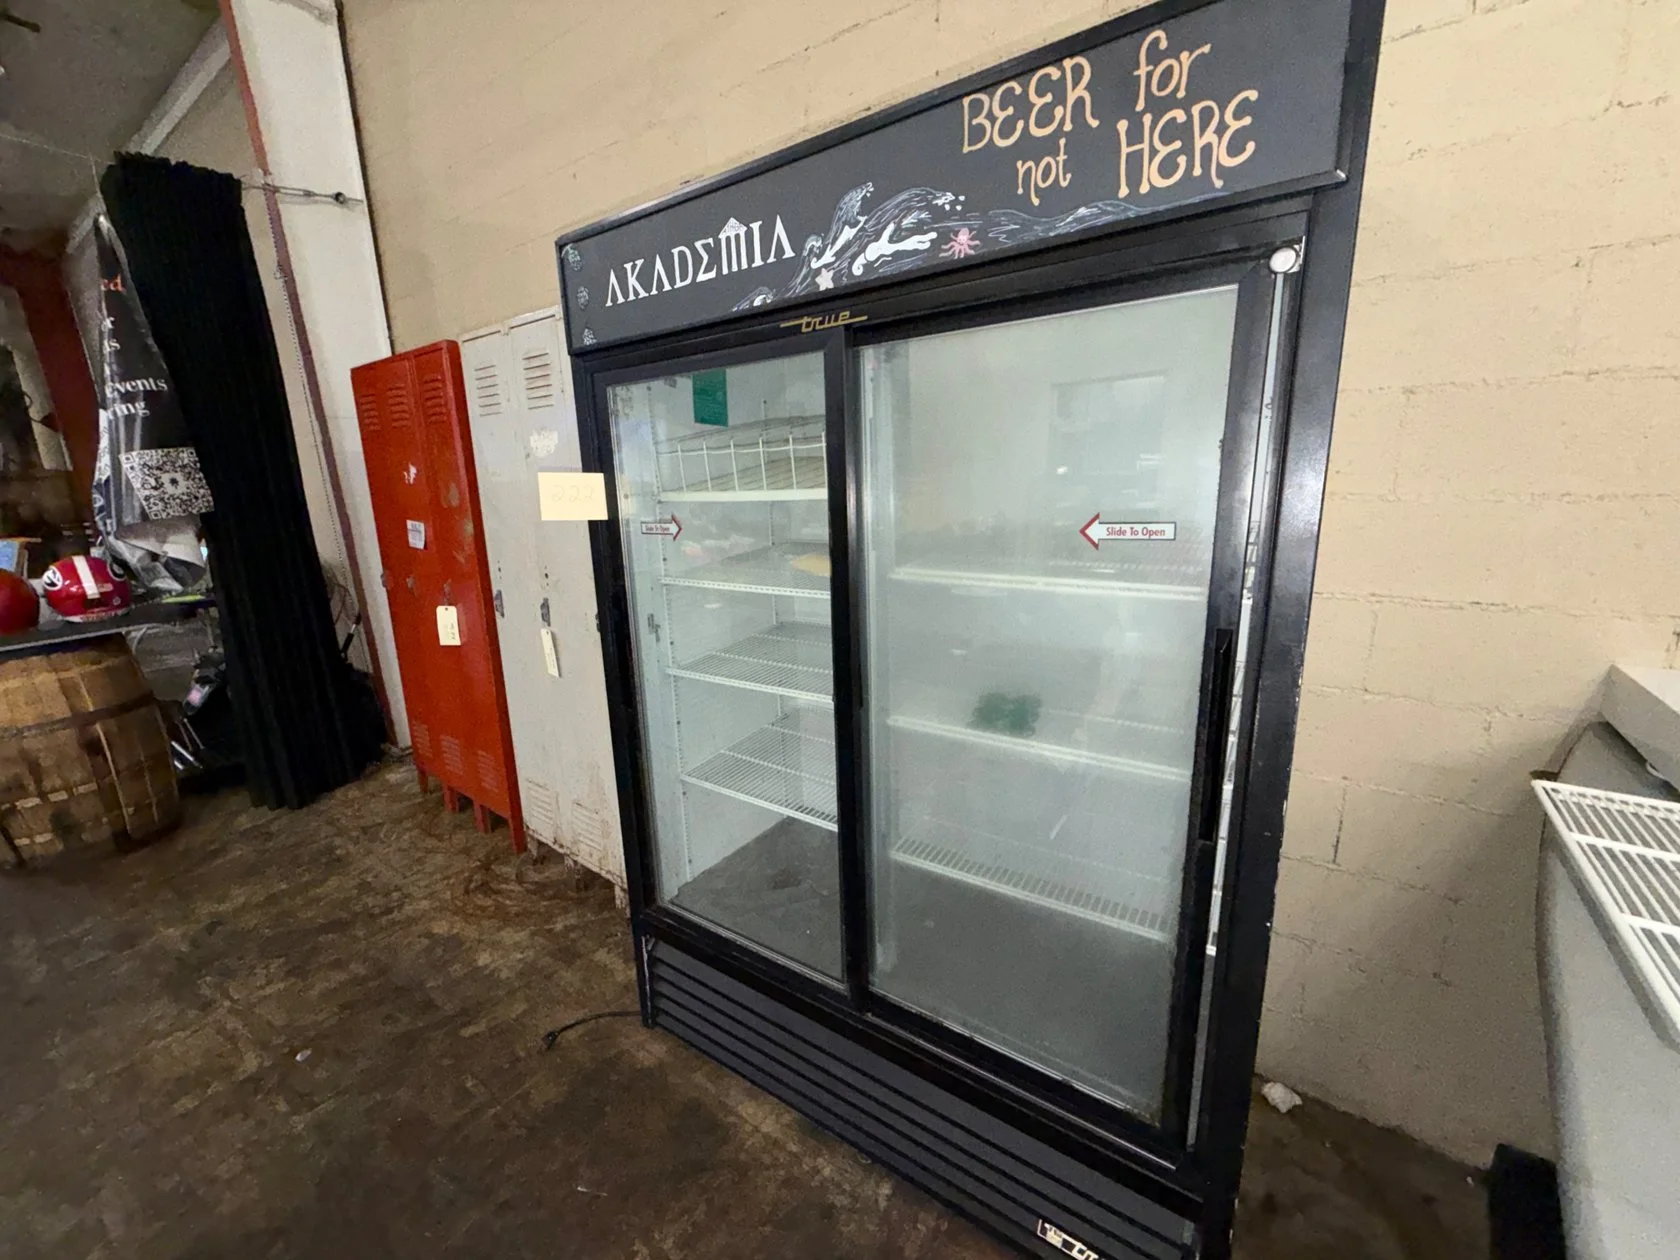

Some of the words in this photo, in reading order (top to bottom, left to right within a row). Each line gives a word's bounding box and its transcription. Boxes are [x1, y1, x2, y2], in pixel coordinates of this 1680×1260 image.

[963, 56, 1099, 153] BEER
[1133, 29, 1211, 112] for
[1016, 138, 1071, 206] not
[1117, 89, 1258, 198] HERE
[1106, 526, 1127, 537] Slide
[1130, 526, 1139, 536] To
[1141, 526, 1166, 539] Open
